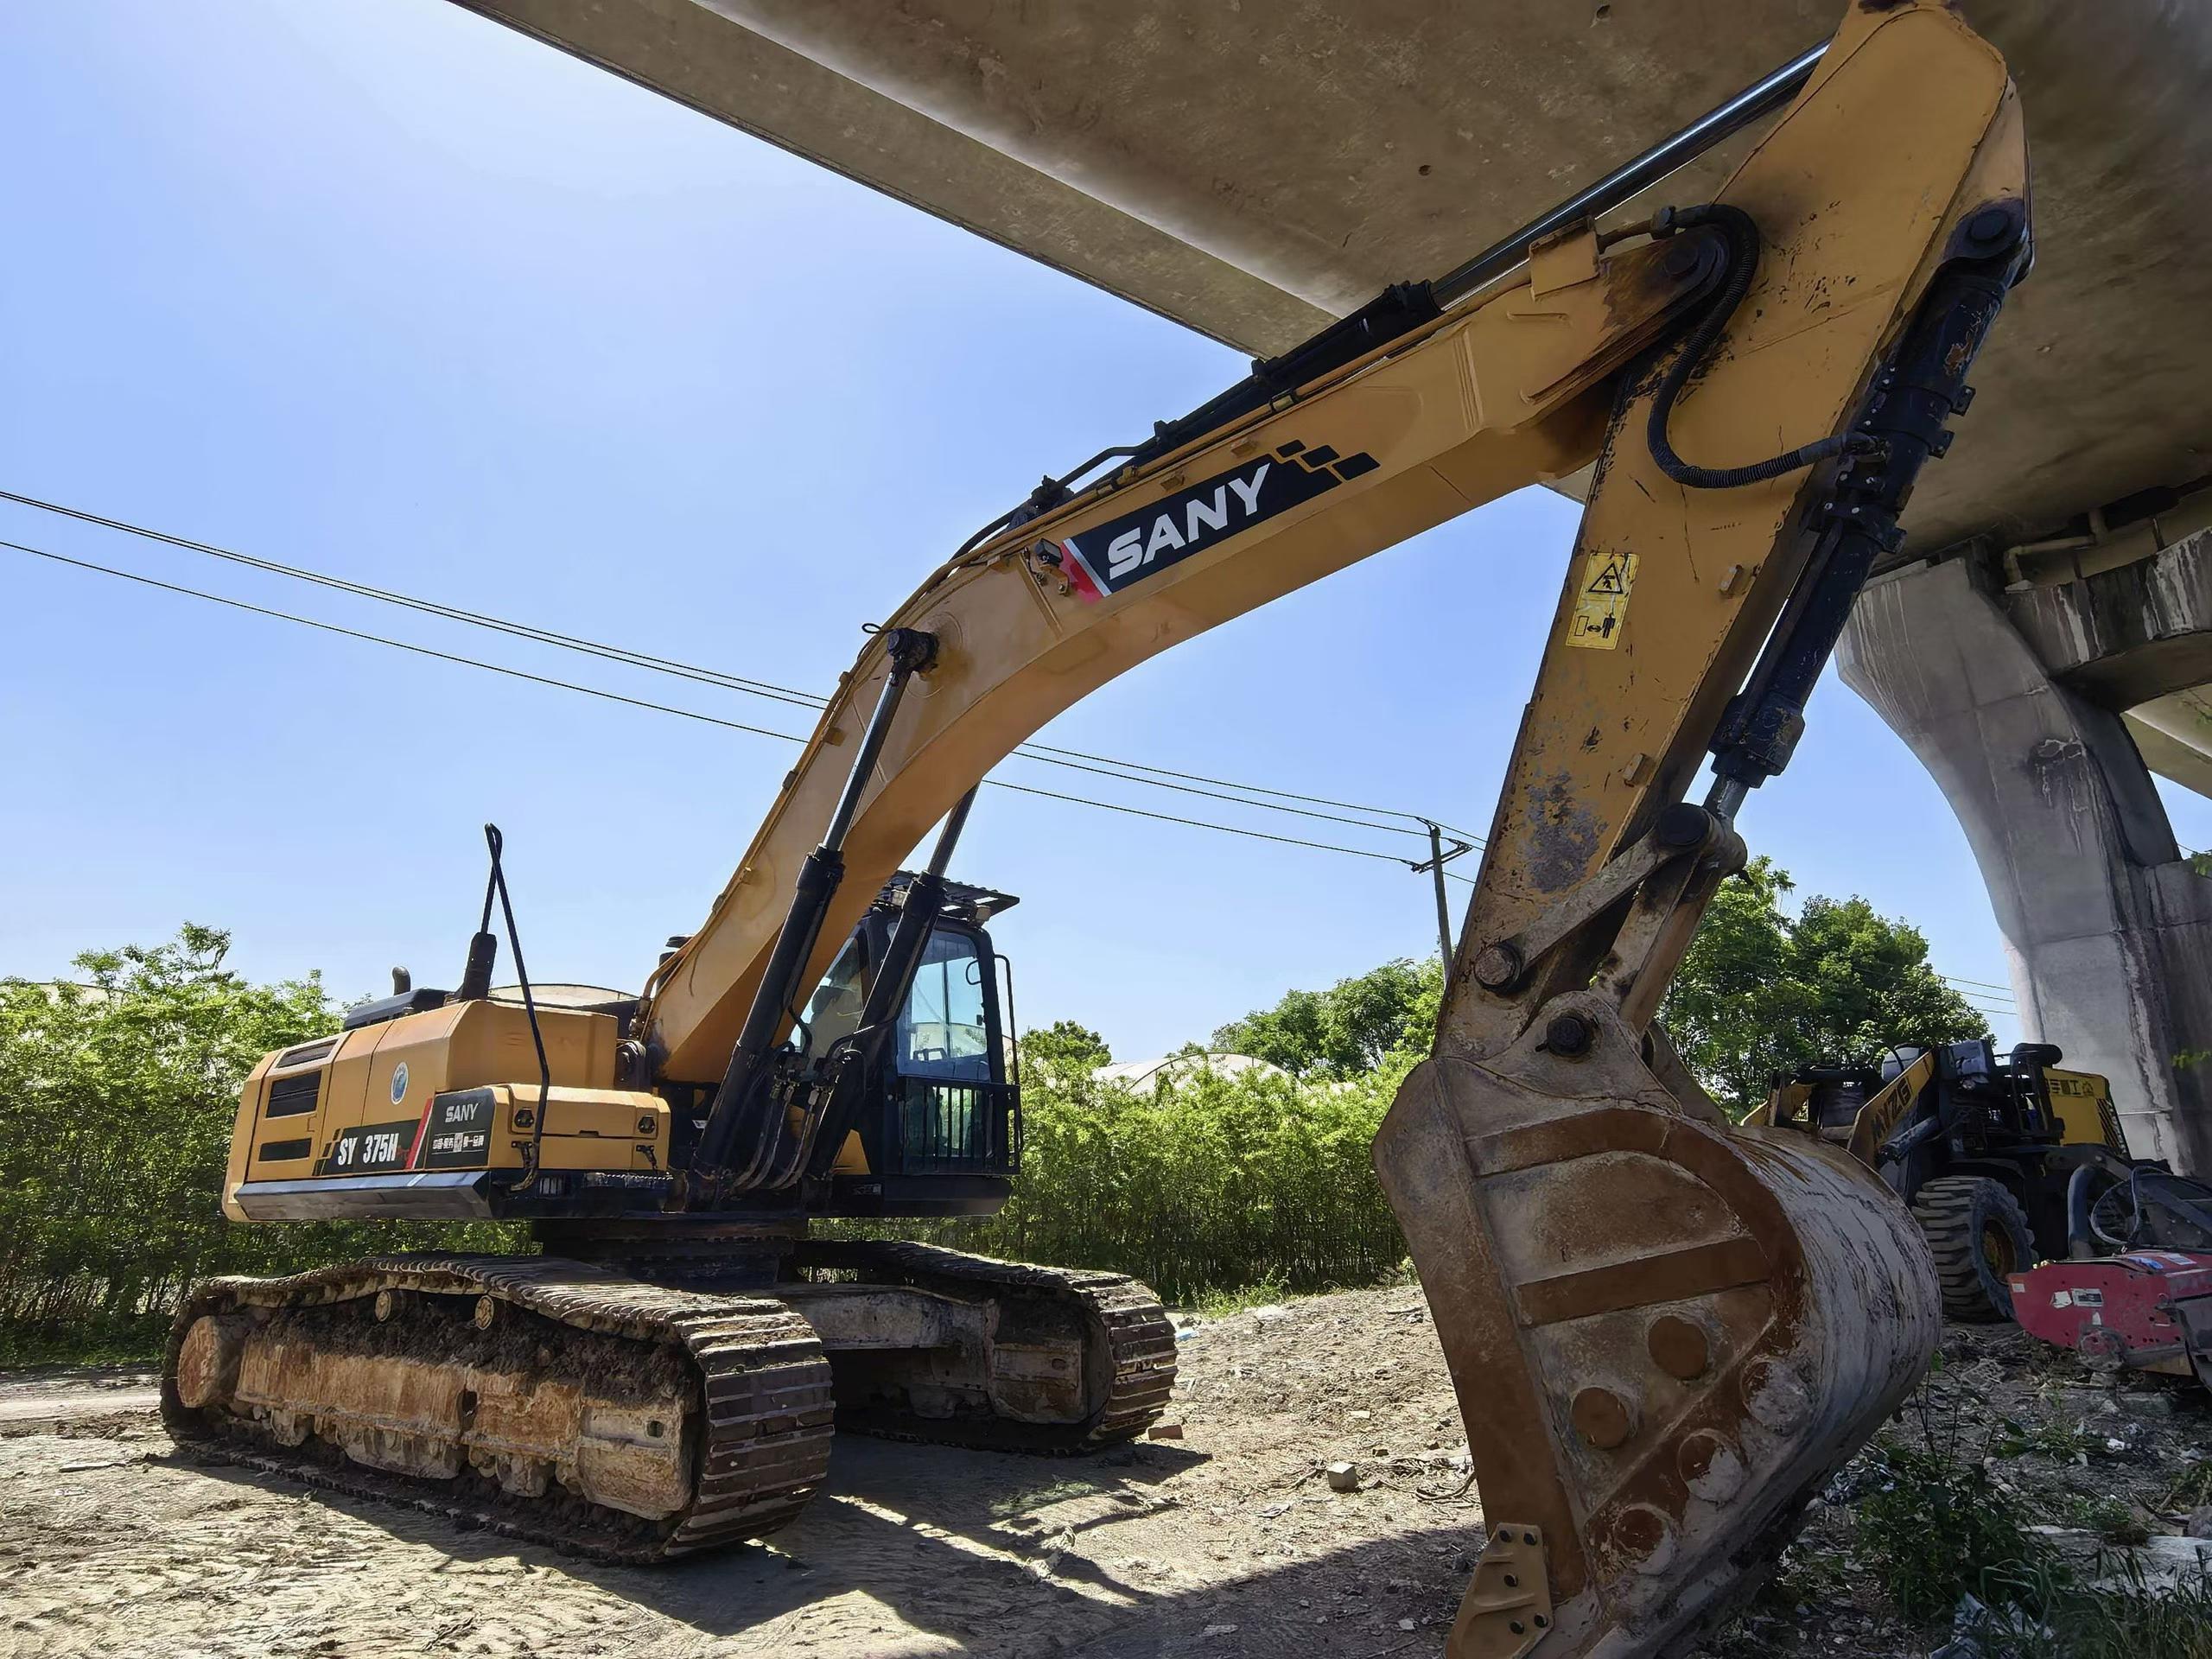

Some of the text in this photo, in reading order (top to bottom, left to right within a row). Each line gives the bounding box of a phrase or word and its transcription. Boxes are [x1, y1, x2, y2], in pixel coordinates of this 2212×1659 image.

[1108, 463, 1270, 580] SANY
[445, 1103, 479, 1122] SANY
[338, 1136, 358, 1166] SY
[363, 1133, 399, 1164] 375H
